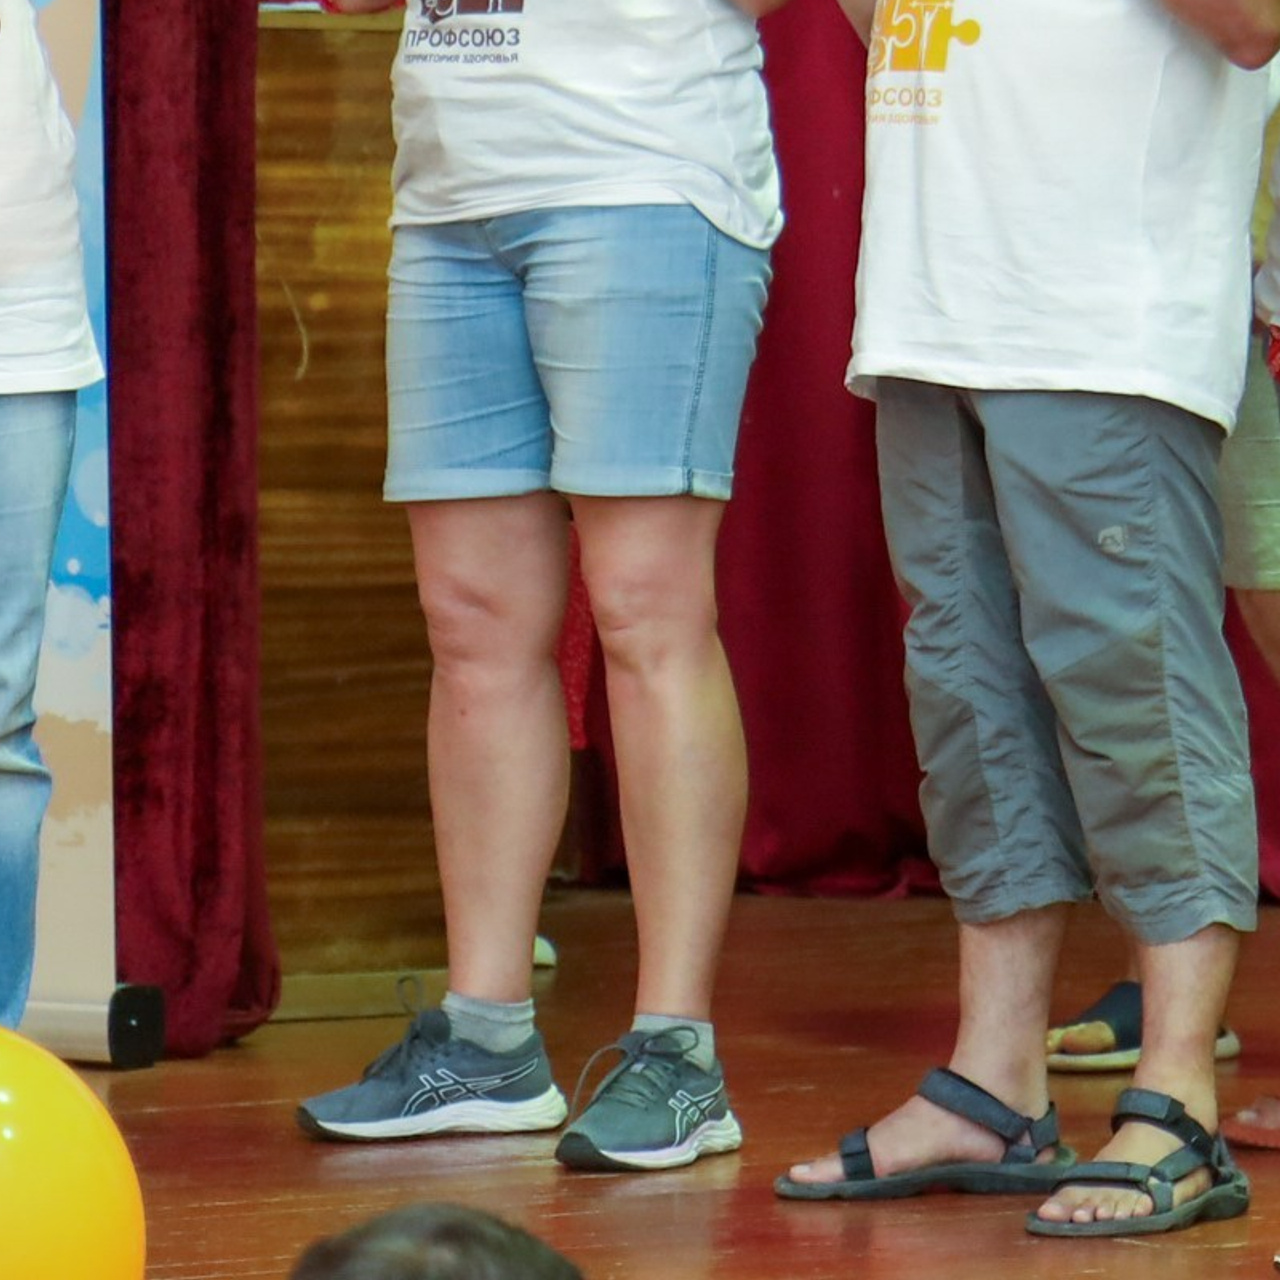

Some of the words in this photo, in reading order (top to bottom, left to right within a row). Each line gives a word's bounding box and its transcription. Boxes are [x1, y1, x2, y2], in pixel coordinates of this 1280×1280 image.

[405, 28, 520, 48] ПРОФСОЮЗ
[462, 53, 519, 63] ЗДОРОВЬЯ
[869, 87, 942, 108] ФСОЮЗ
